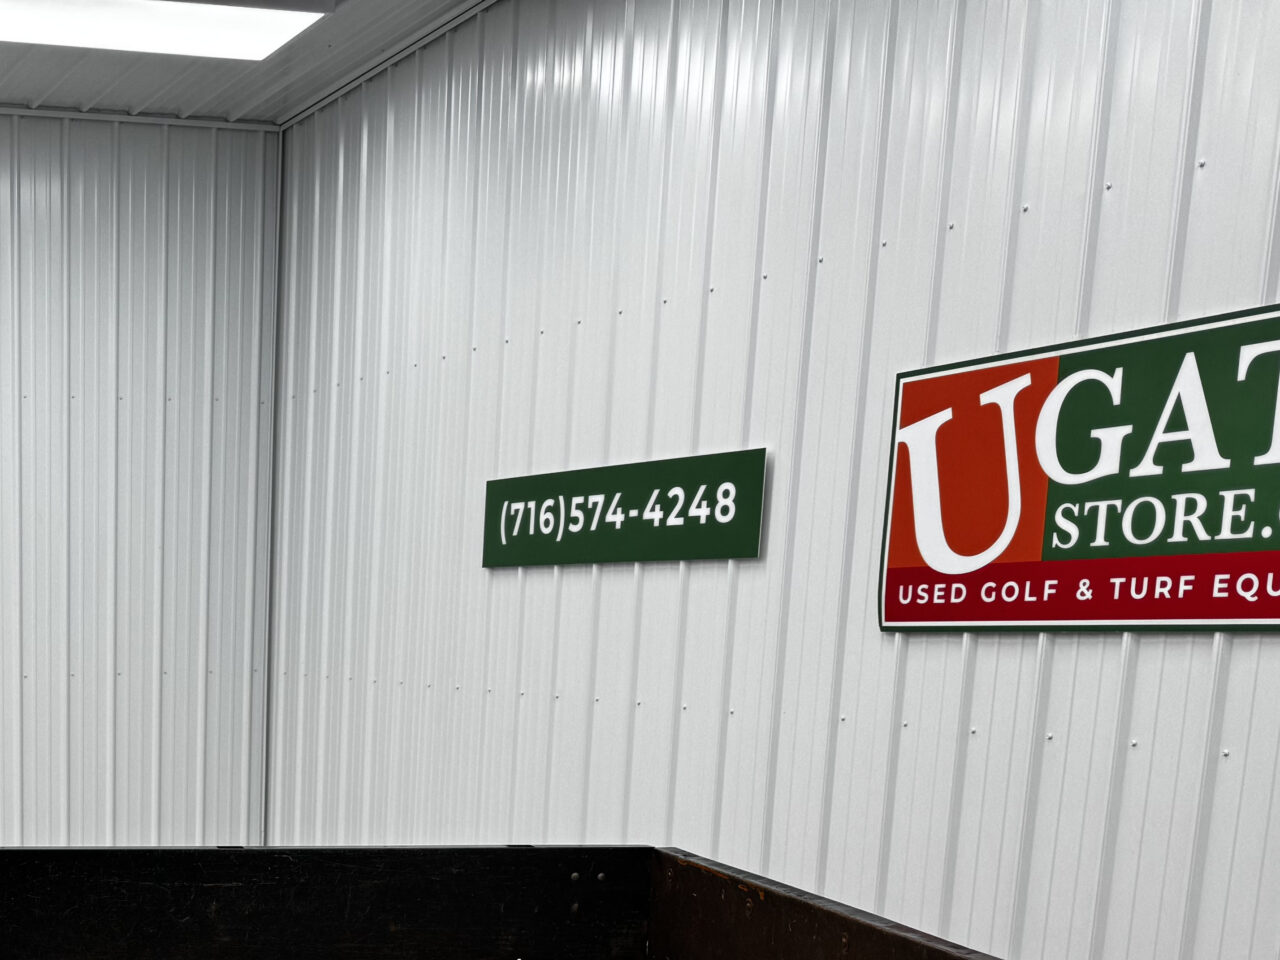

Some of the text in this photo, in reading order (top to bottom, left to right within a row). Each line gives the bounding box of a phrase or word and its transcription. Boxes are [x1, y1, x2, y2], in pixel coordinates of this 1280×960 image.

[500, 482, 736, 545] (716)574-4248
[1052, 488, 1280, 549] STORE.
[898, 583, 967, 605] USED
[980, 580, 1058, 603] GOLF
[1075, 578, 1093, 600] &
[1110, 575, 1195, 600] TURF
